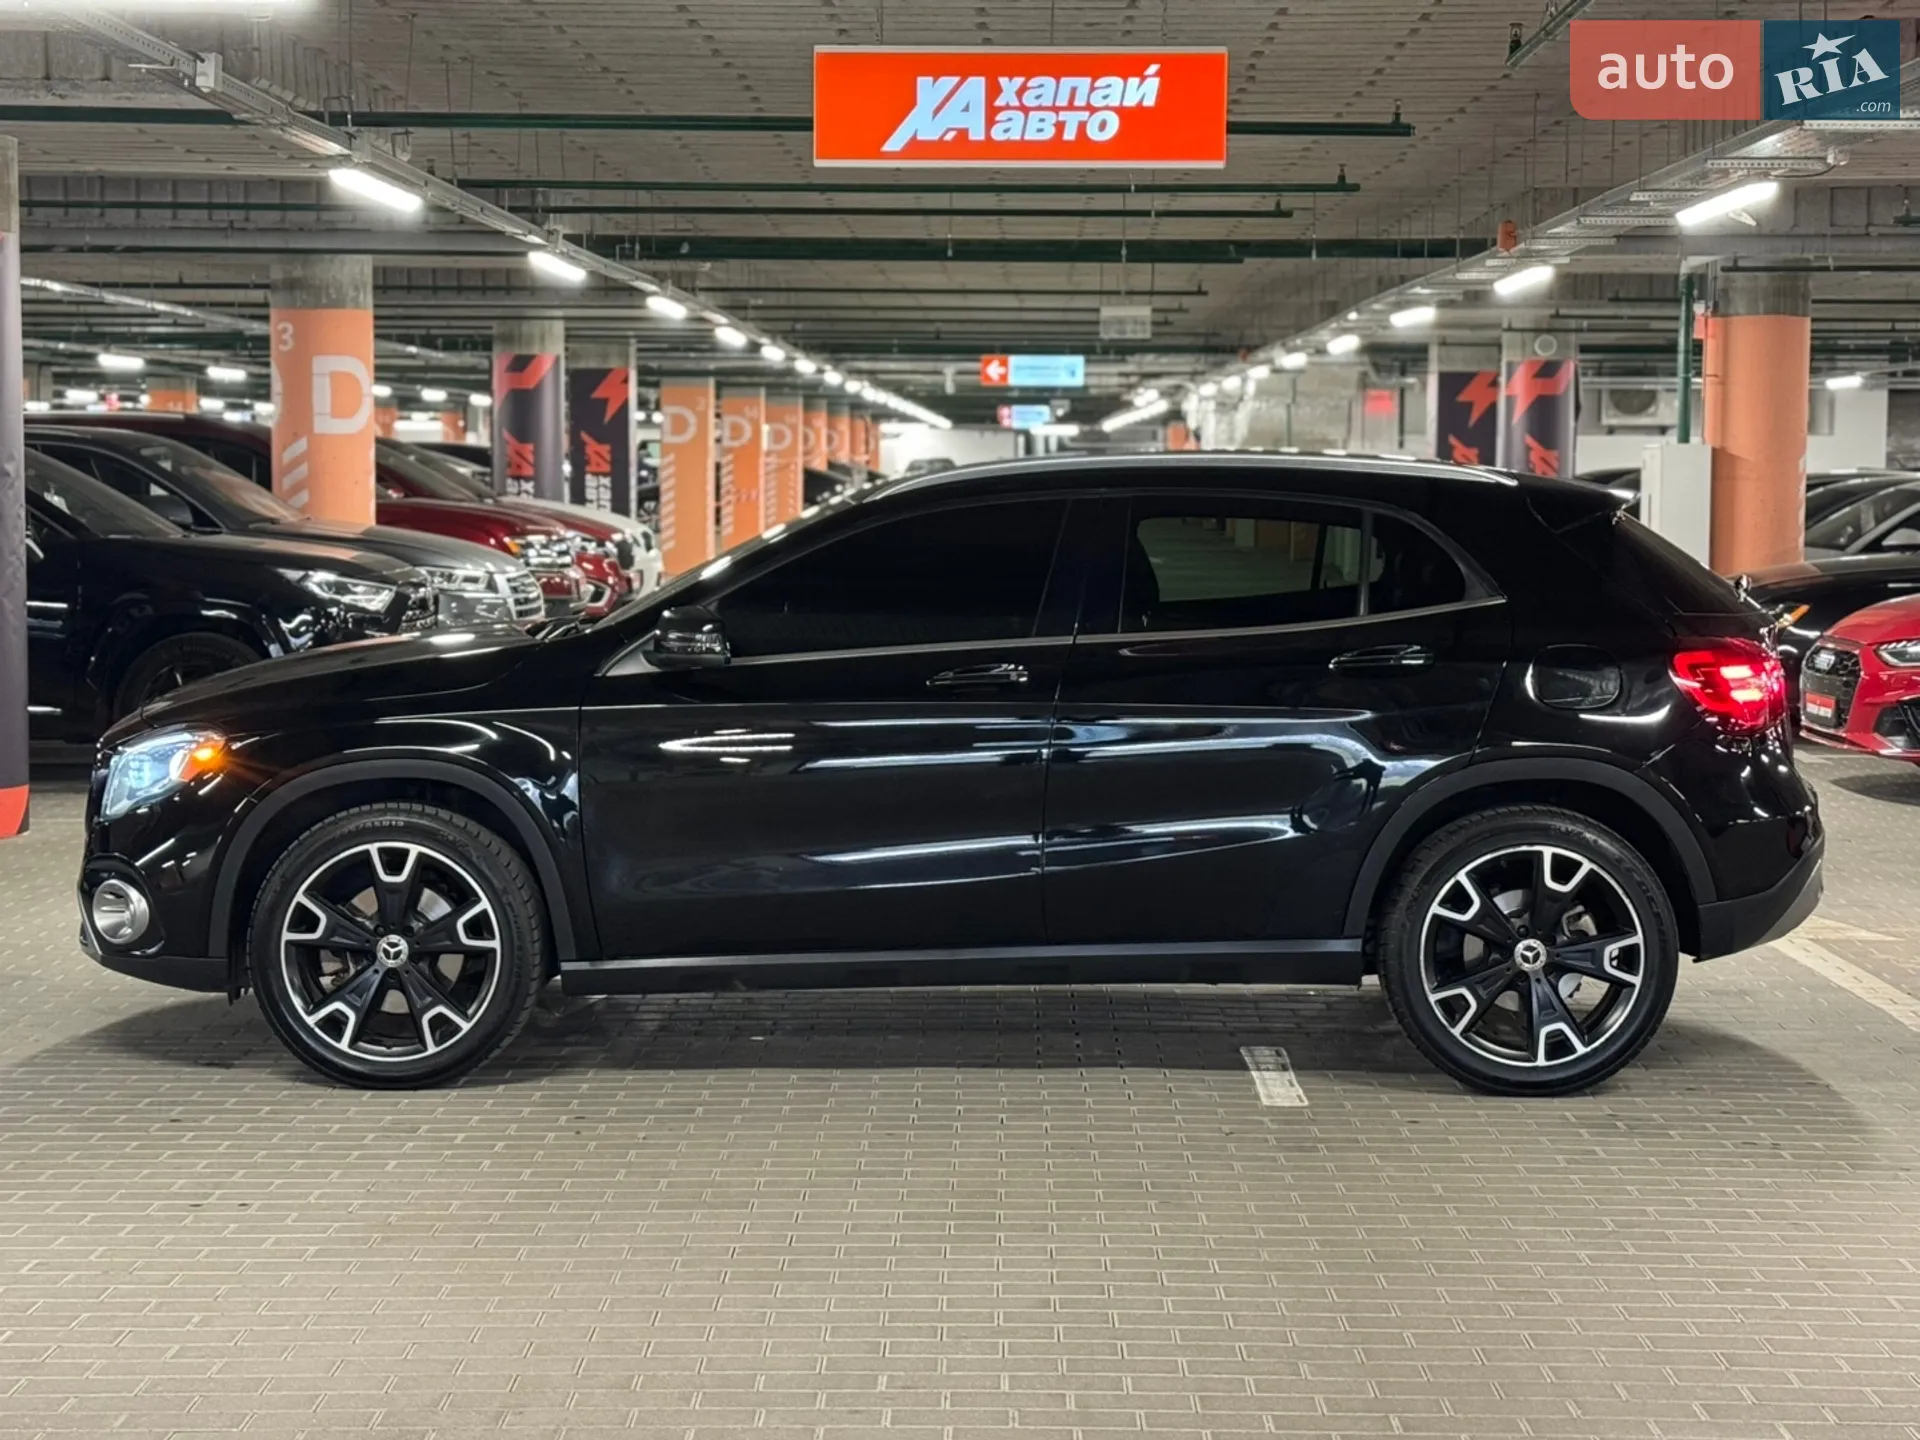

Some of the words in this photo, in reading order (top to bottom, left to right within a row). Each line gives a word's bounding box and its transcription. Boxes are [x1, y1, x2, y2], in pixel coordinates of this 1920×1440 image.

[993, 64, 1161, 107] хапай
[990, 110, 1120, 141] авто
[312, 354, 372, 434] D
[662, 405, 697, 443] D
[721, 415, 752, 447] D
